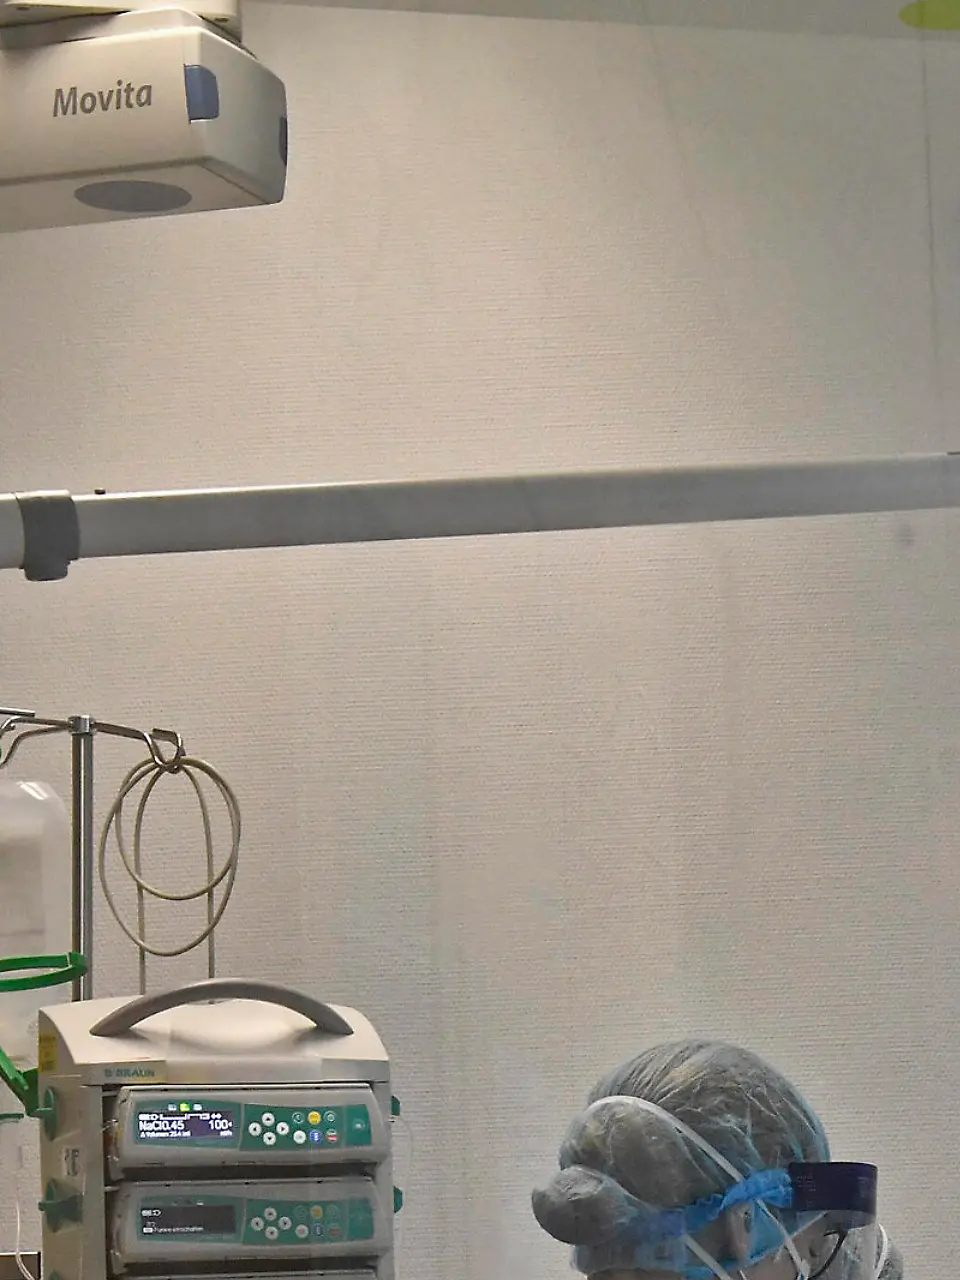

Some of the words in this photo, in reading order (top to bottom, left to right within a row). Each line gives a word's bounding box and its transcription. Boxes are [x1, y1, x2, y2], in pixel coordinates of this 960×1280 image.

[52, 79, 153, 117] Movita
[116, 1069, 155, 1078] BRAUN
[208, 1119, 229, 1131] 100
